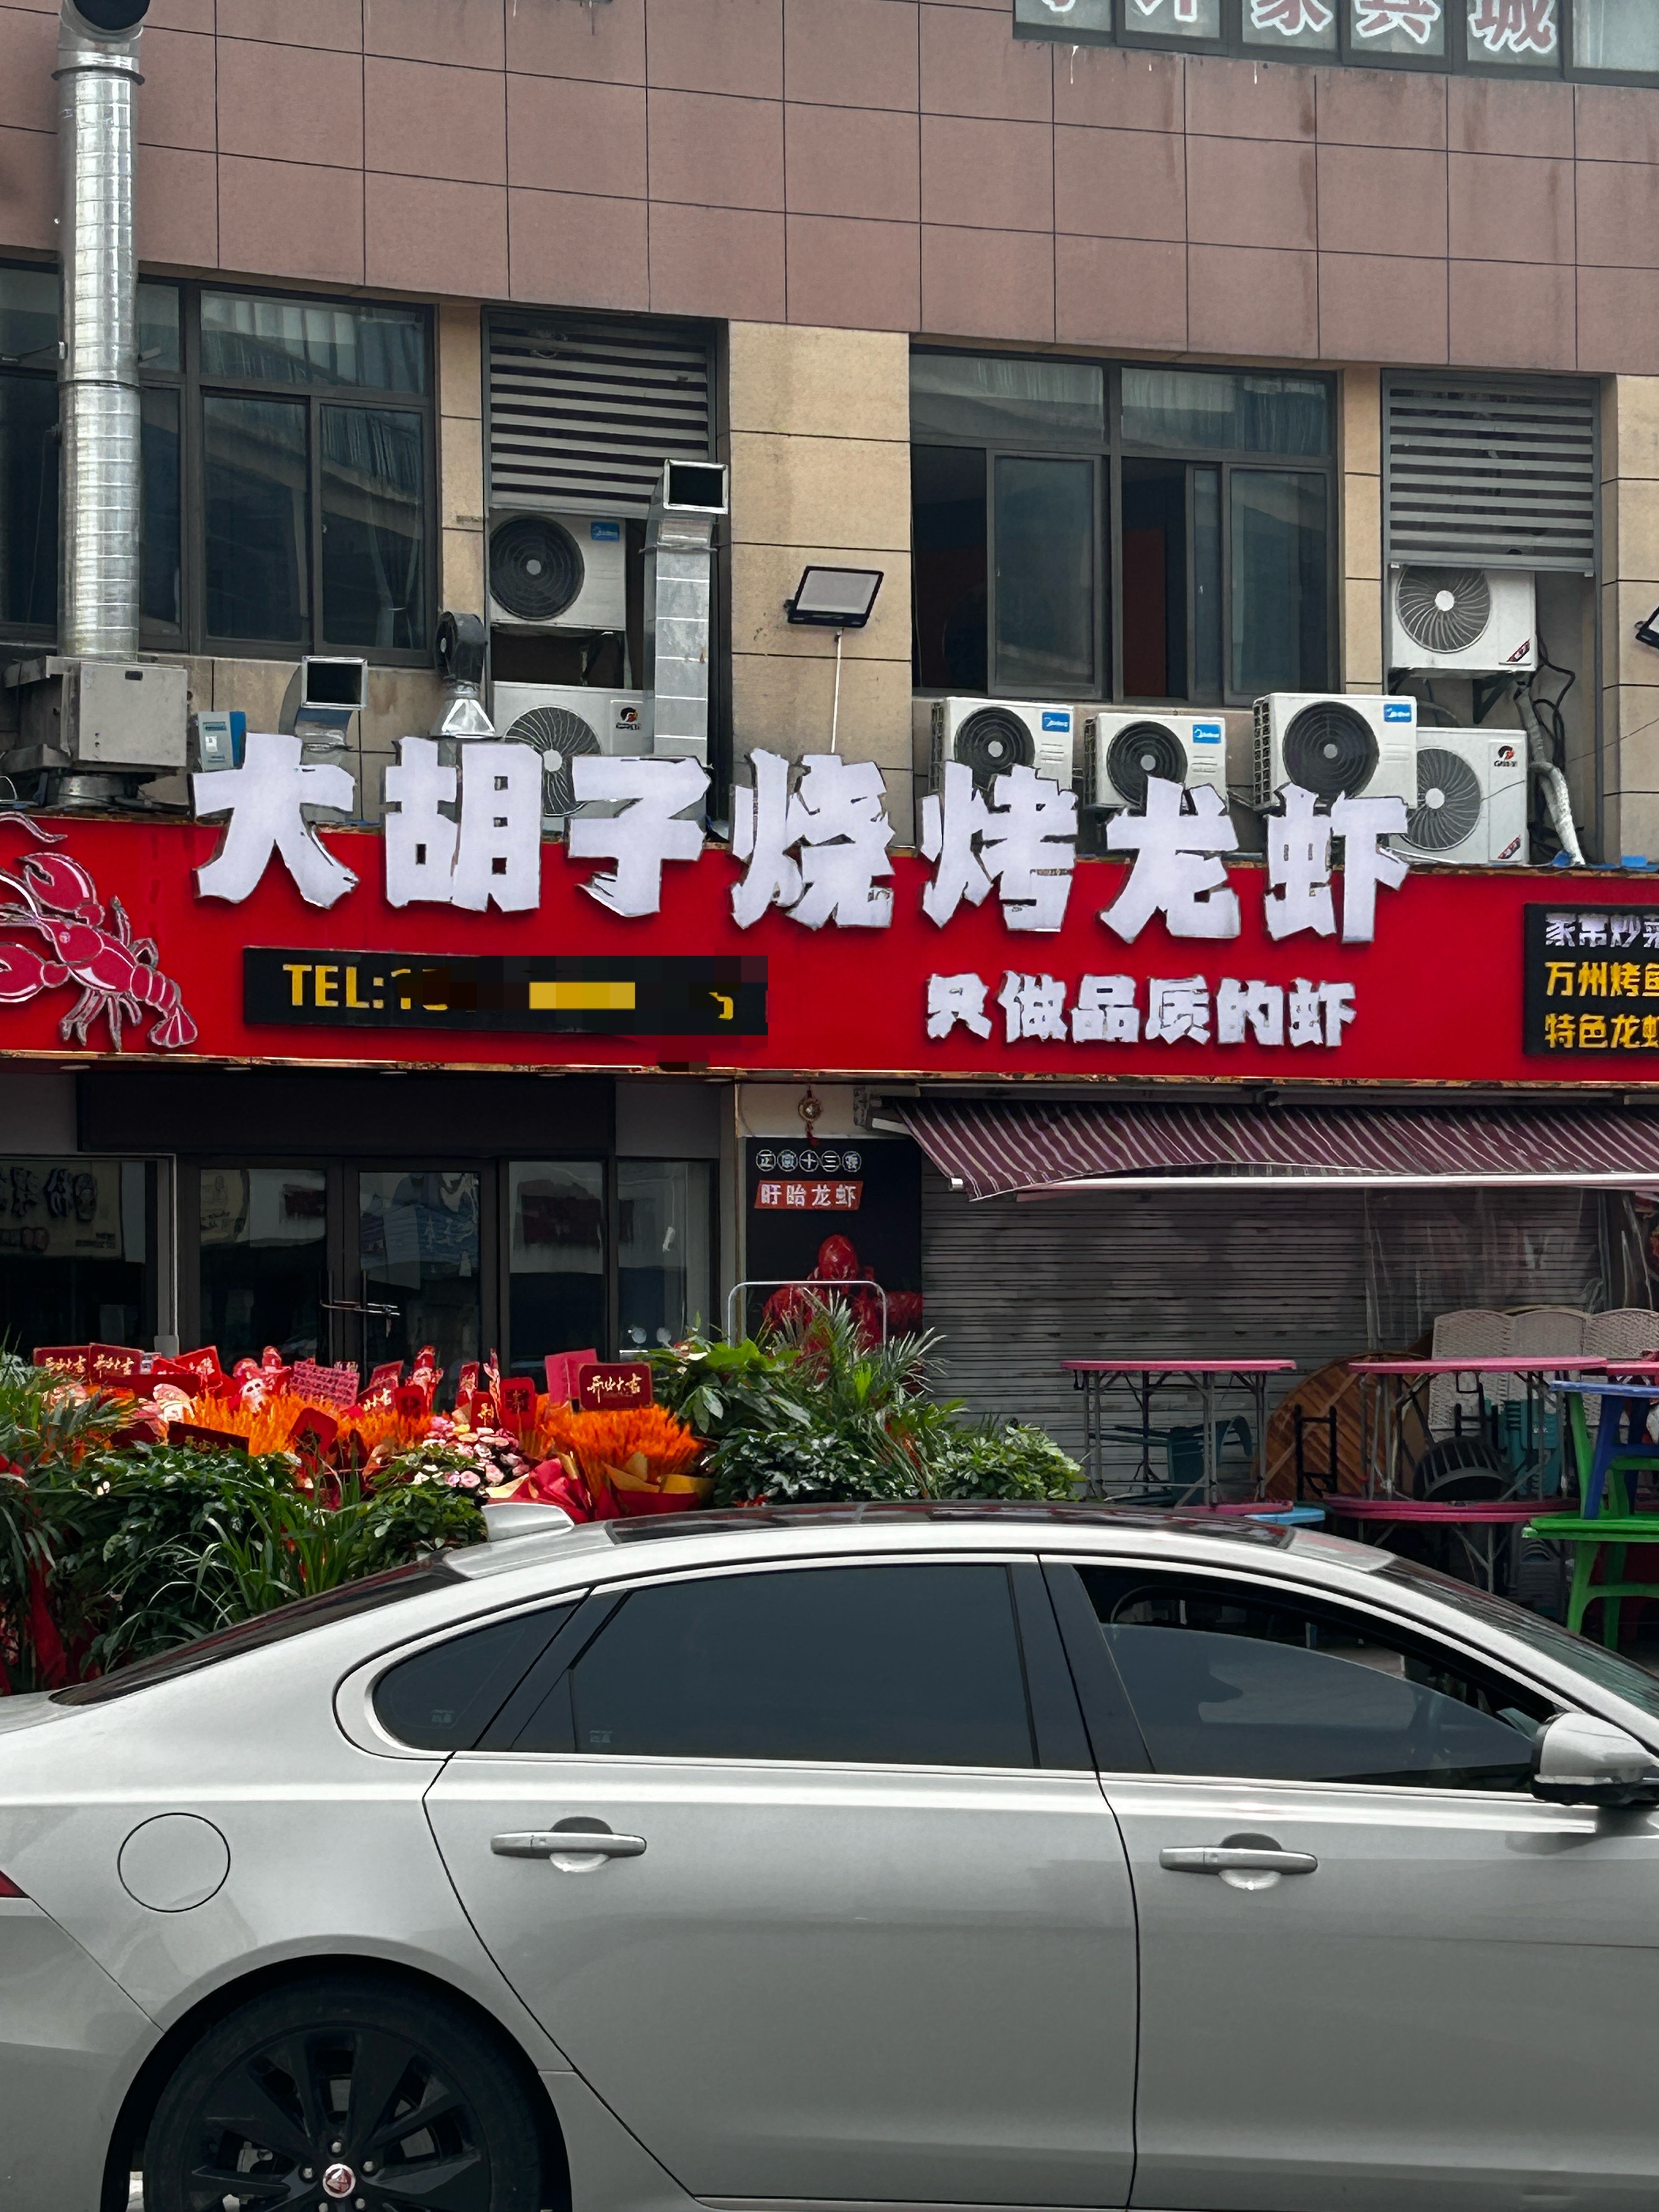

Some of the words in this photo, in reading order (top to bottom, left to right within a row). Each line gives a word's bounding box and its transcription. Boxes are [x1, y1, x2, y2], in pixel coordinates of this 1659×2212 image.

[193, 732, 1410, 944] 大胡子烧烤龙虾
[926, 971, 1356, 1047] 只做品质的虾
[760, 1183, 857, 1207] 盱眙龙虾
